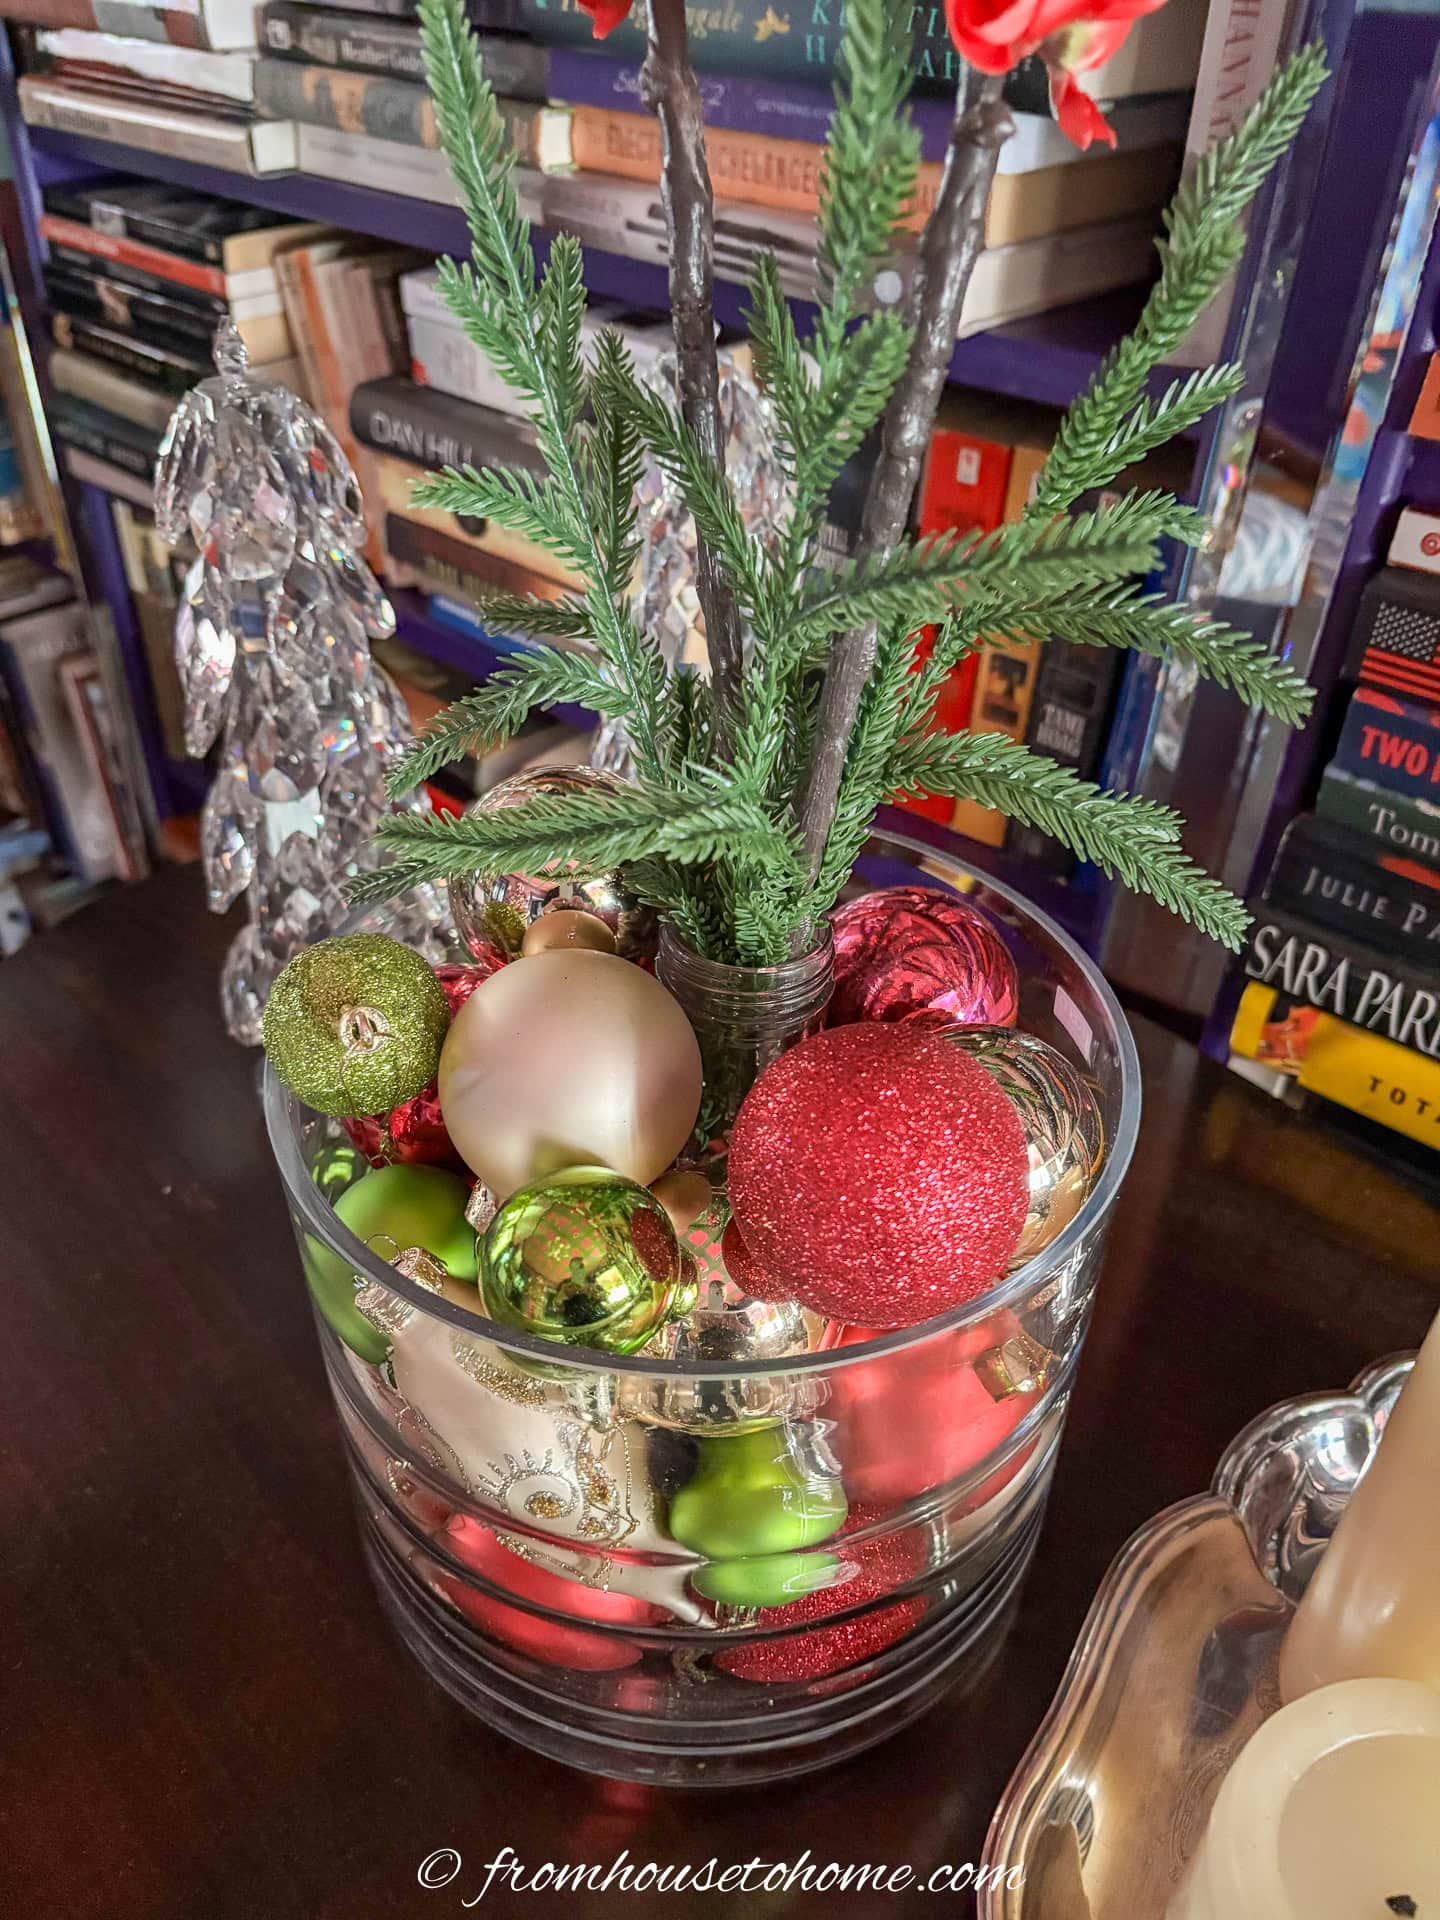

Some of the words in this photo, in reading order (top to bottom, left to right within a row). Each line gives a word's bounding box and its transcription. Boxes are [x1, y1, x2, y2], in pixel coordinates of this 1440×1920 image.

[1359, 724, 1430, 777] TWO
[1367, 802, 1440, 858] Tom
[1302, 867, 1387, 920] JULIE
[1245, 924, 1351, 1017] SARA
[1366, 1073, 1440, 1125] TOT
